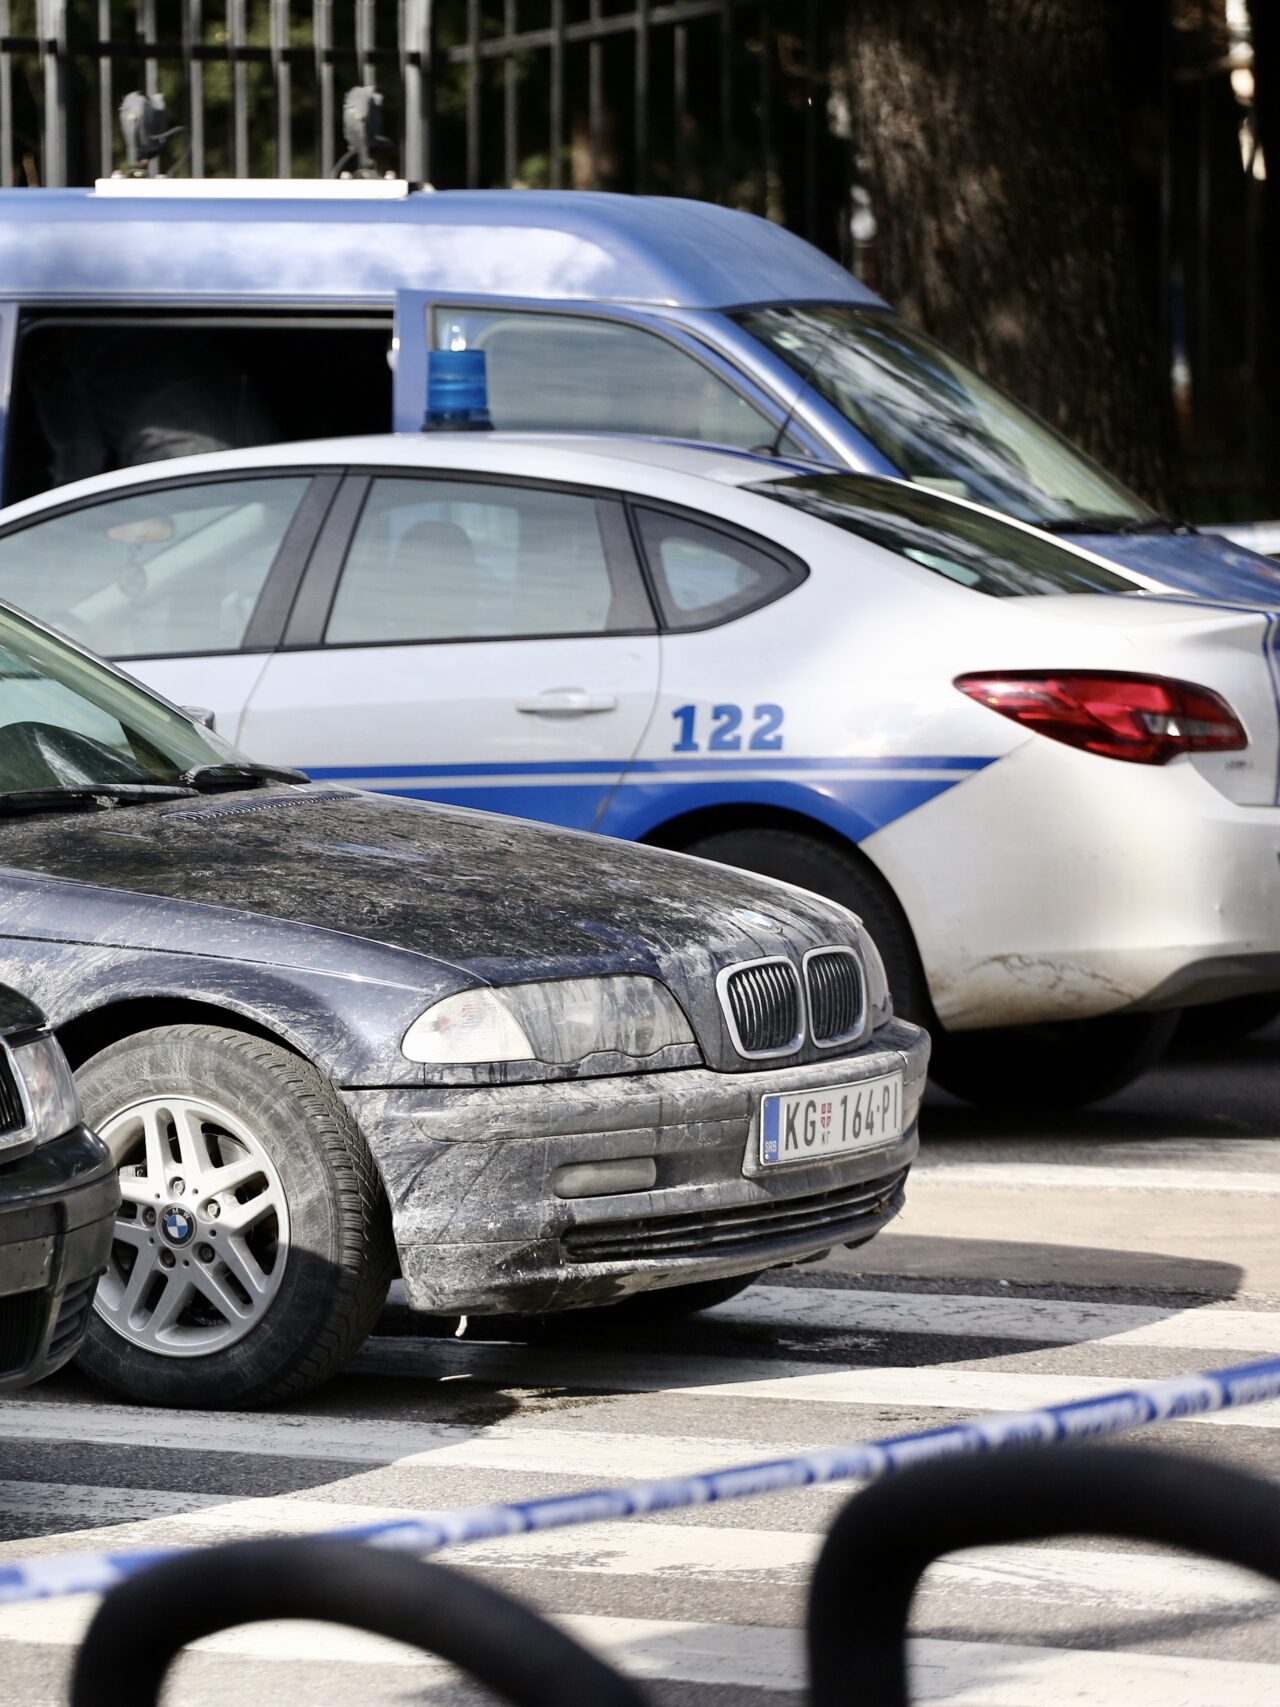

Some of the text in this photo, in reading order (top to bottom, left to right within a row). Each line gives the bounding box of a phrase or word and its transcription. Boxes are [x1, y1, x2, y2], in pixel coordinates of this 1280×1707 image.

[672, 703, 784, 752] 122
[785, 1100, 817, 1150] KG
[764, 1140, 778, 1153] SRB
[163, 1208, 191, 1221] BMW
